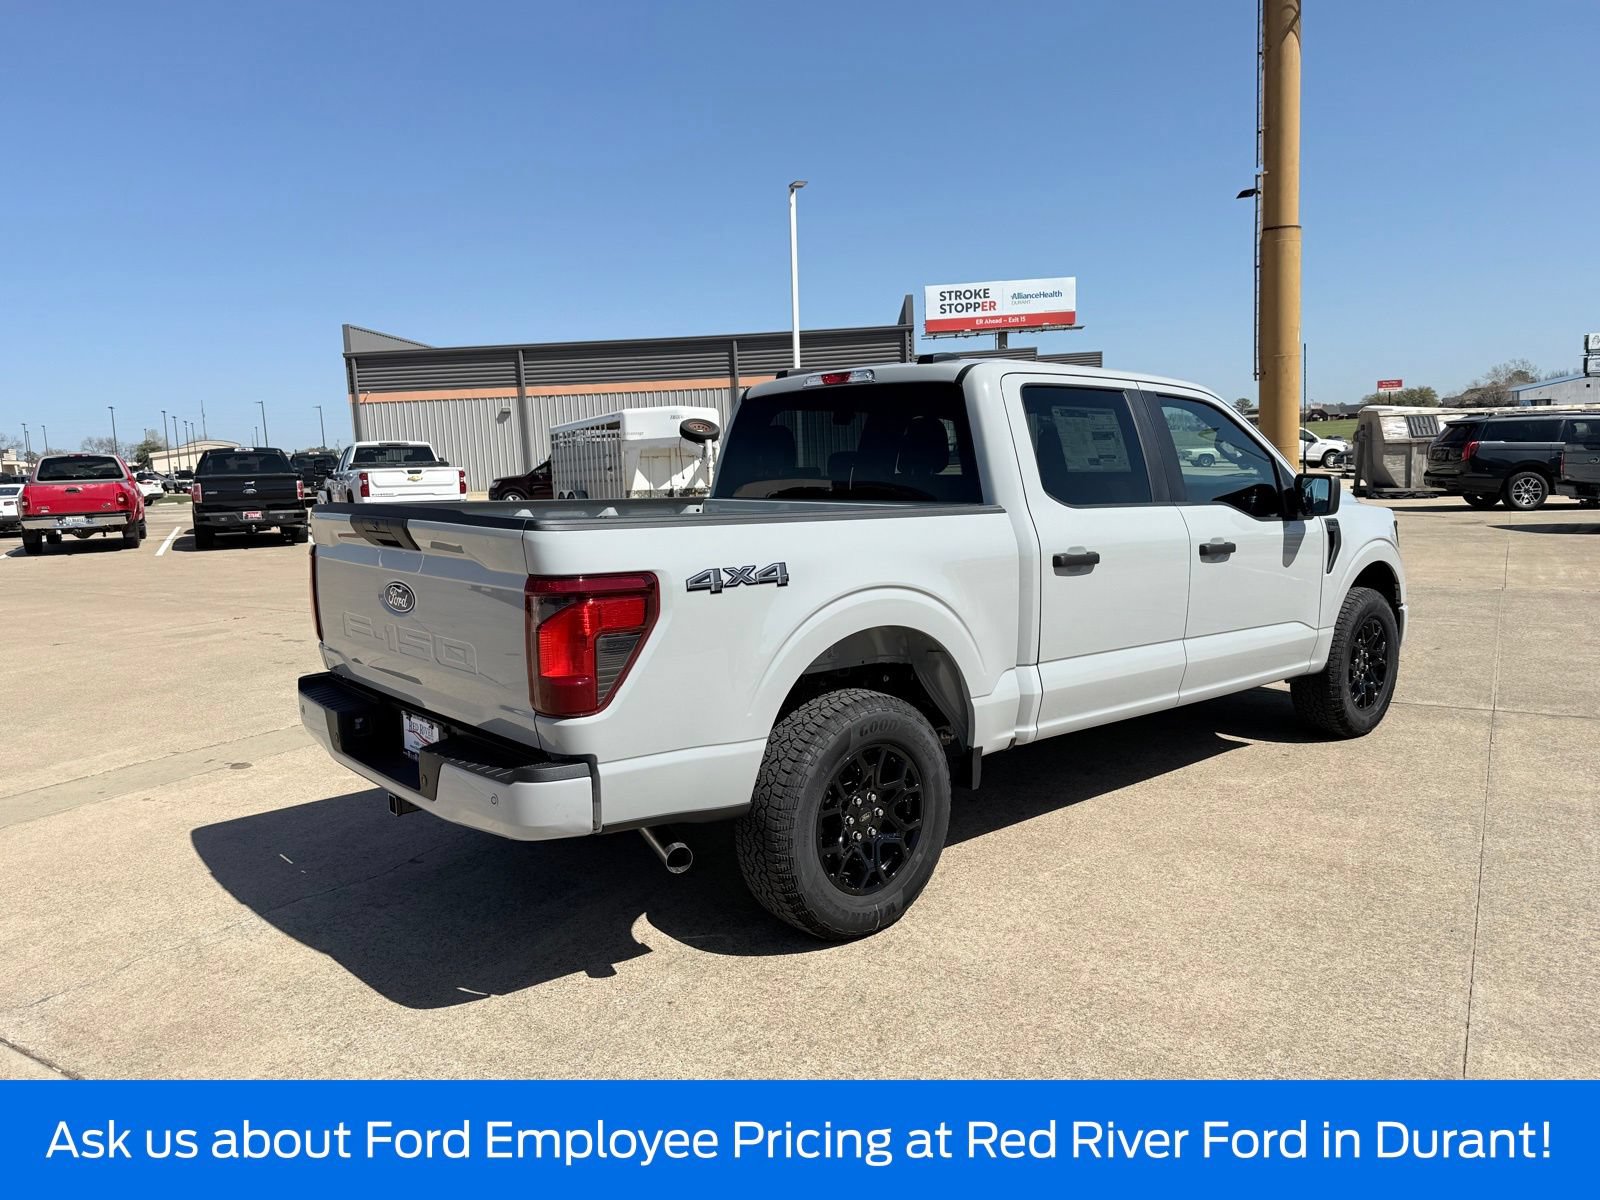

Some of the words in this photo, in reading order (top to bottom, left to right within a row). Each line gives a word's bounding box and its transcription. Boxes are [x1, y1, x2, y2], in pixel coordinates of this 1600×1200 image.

[940, 288, 990, 301] STROKE
[1011, 289, 1063, 300] AllianceHealth
[940, 301, 996, 314] STOPPER
[984, 317, 1003, 325] Ahead
[388, 585, 408, 609] Ford
[343, 611, 479, 676] F-150
